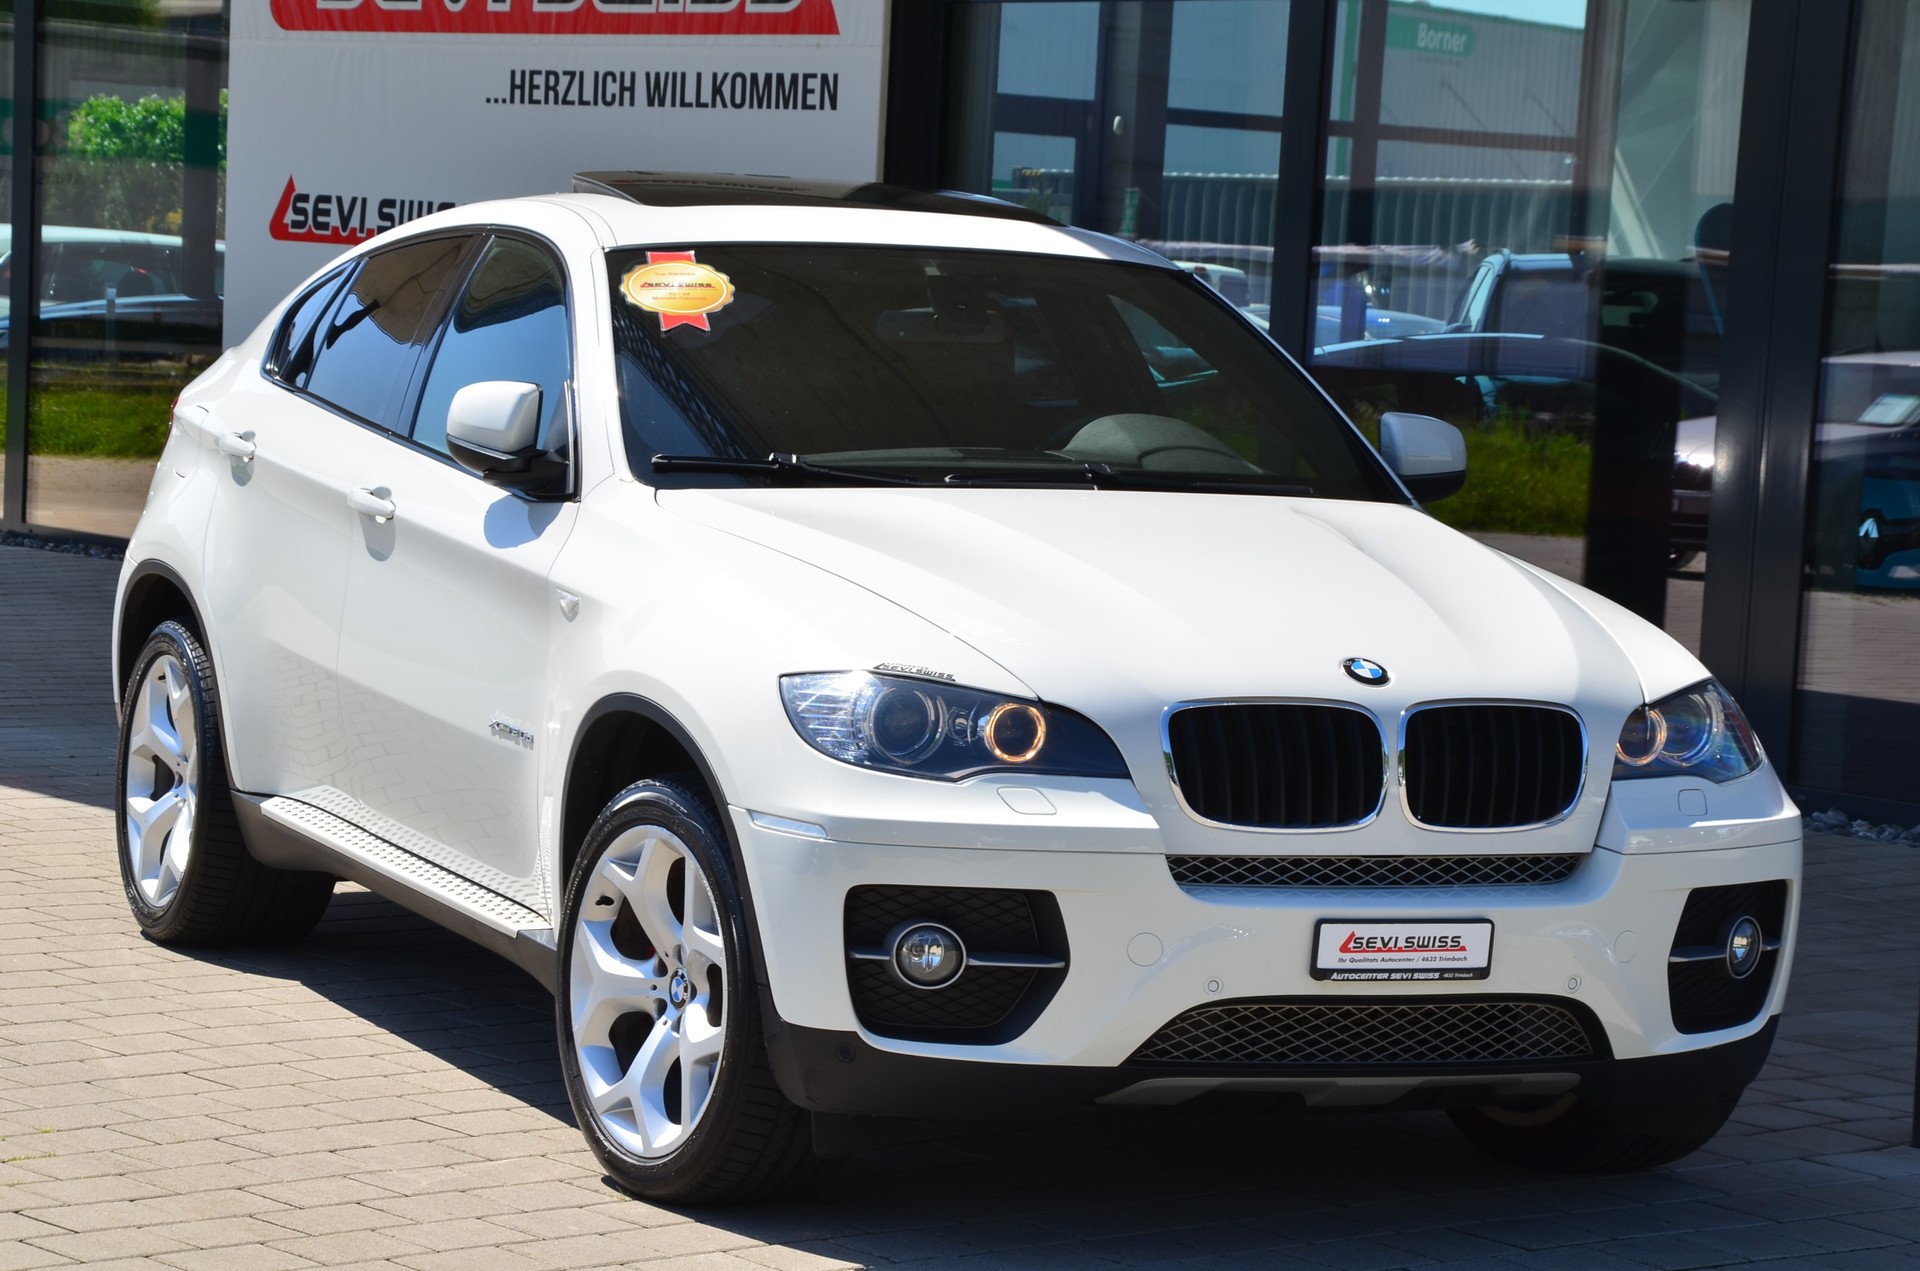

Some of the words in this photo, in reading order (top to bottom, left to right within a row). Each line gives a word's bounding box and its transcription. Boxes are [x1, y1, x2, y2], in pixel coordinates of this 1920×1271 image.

[1418, 23, 1467, 51] Borner
[485, 69, 636, 107] ...HERZLICH
[645, 71, 839, 111] WILLKOMMEN
[290, 193, 367, 234] SEVI
[1352, 936, 1399, 950] SEVI
[1403, 935, 1462, 949] SWISS
